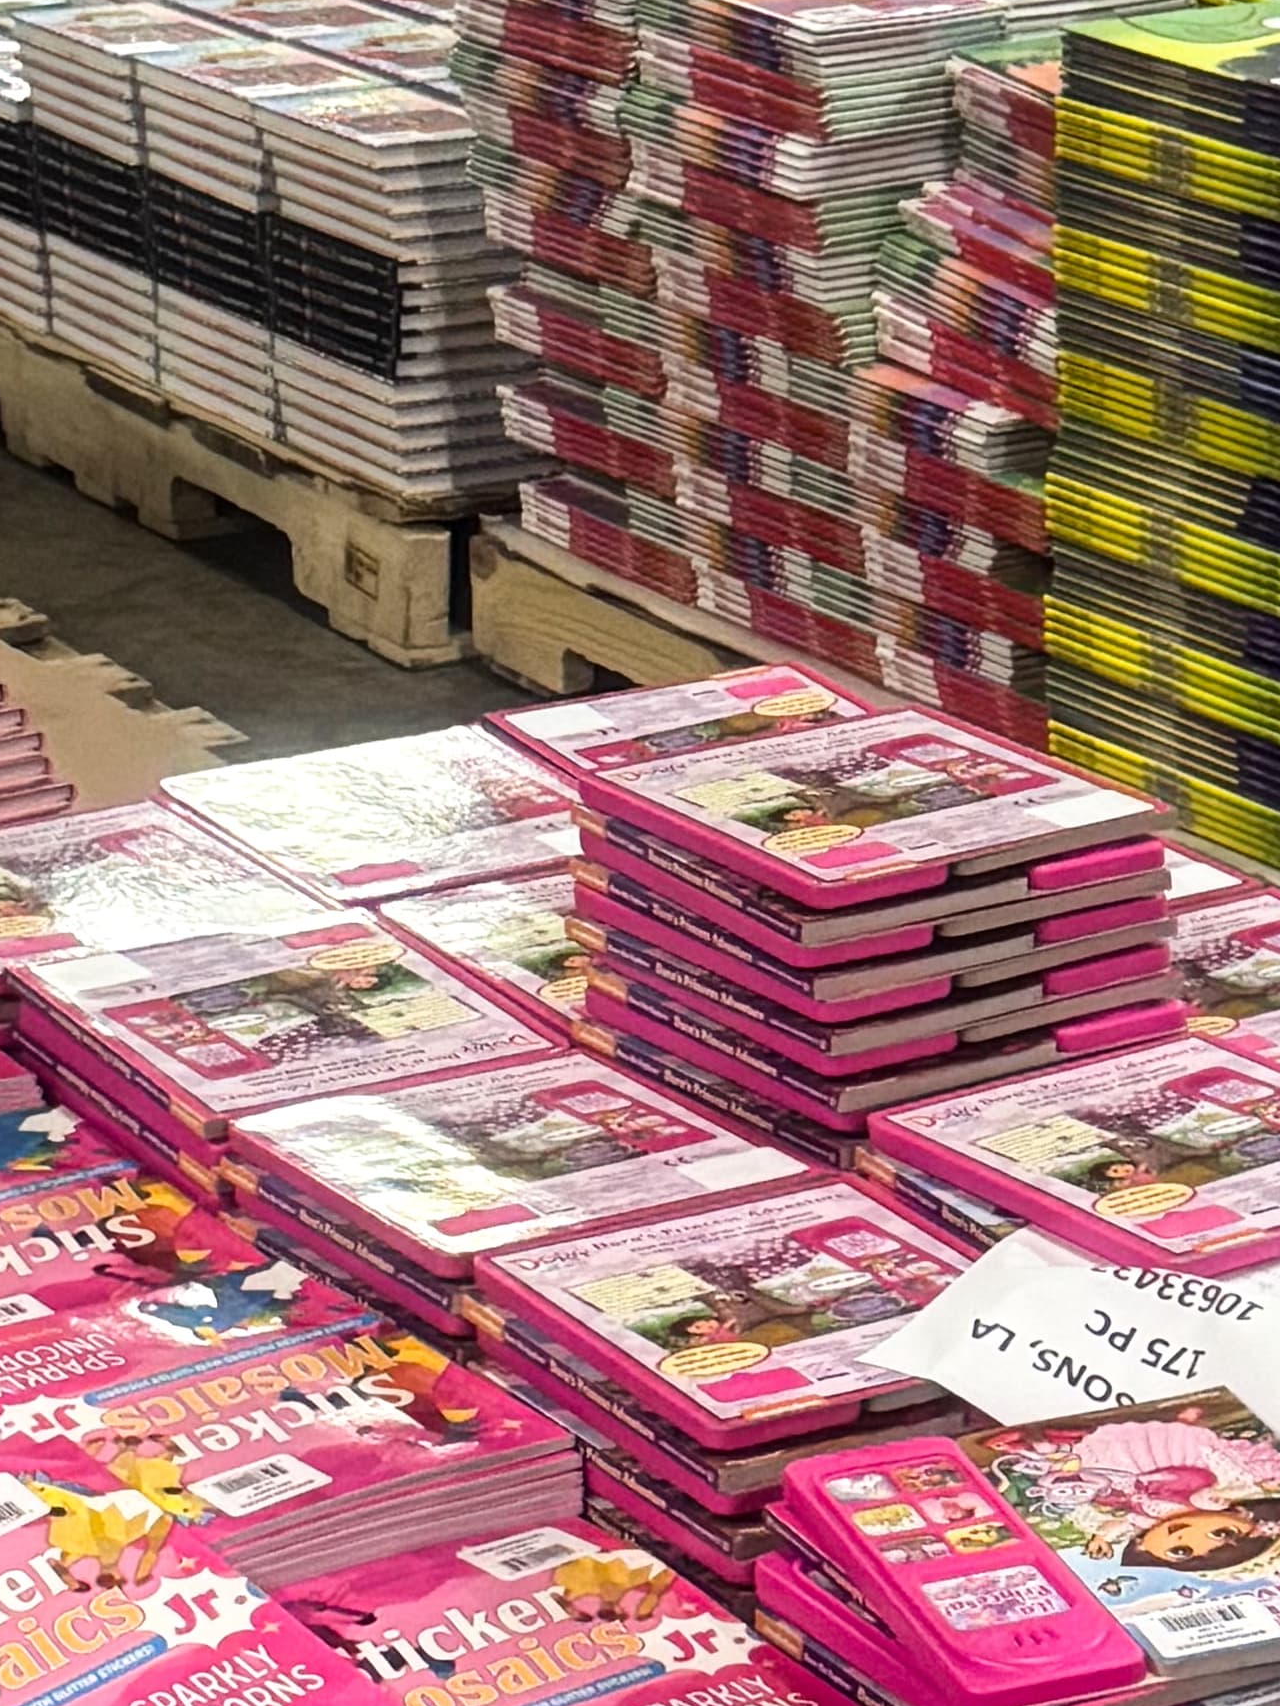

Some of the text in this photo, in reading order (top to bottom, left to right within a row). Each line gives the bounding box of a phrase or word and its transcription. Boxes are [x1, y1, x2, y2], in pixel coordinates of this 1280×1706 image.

[1091, 1266, 1264, 1321] 106334
[971, 1318, 1016, 1352] LA
[1085, 1309, 1206, 1379] 175 PC
[99, 1335, 399, 1436] Mosaics
[170, 1372, 417, 1466] Sticker
[170, 1587, 222, 1635] Jr
[358, 1586, 570, 1682] ticker
[672, 1630, 718, 1662] Jr
[52, 1673, 99, 1703] GLITTER
